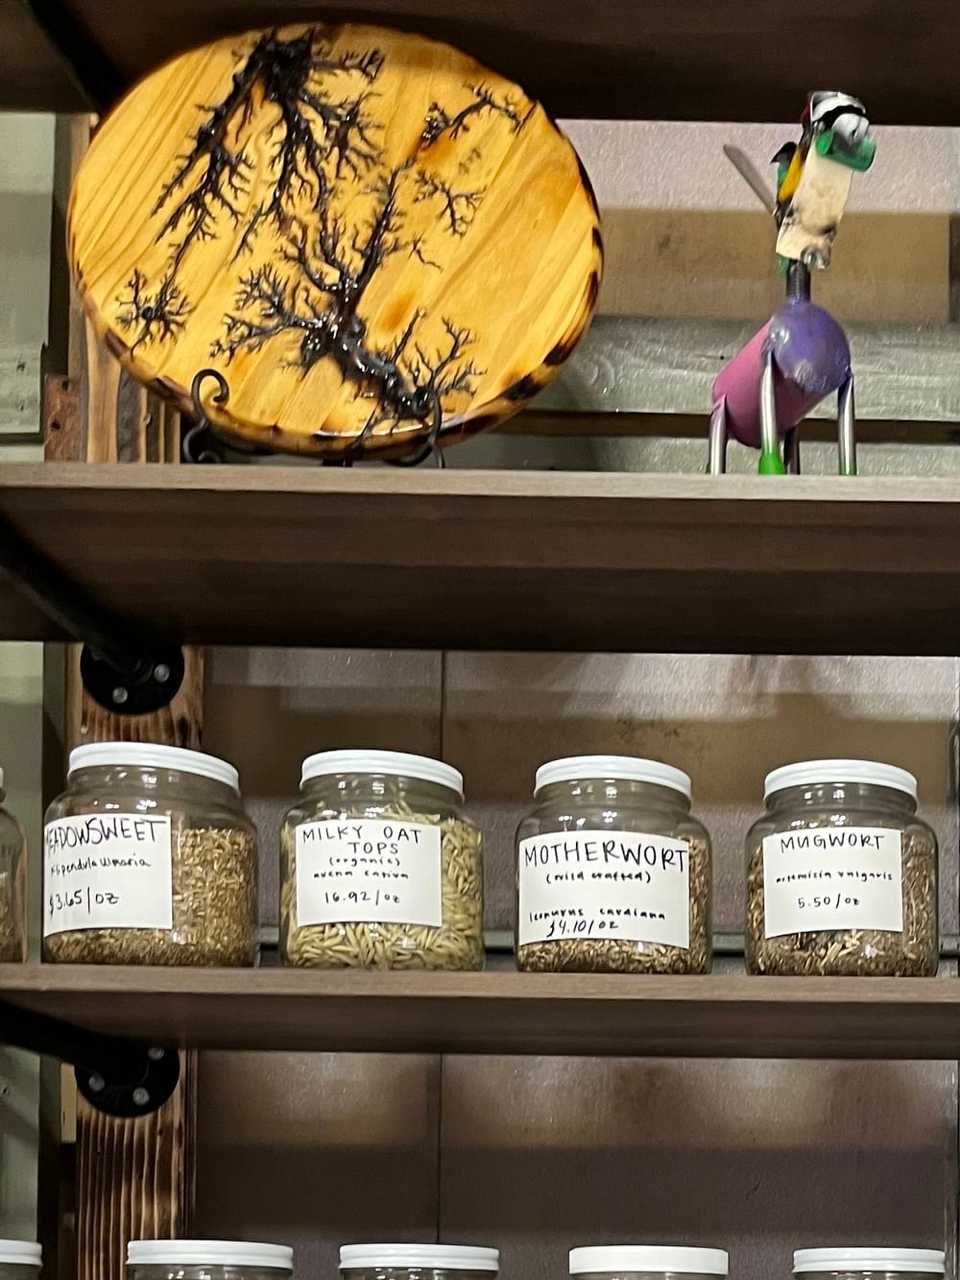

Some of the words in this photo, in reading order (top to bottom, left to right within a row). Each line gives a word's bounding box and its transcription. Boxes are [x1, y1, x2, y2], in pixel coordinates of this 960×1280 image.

[303, 826, 362, 843] MILKY
[383, 826, 422, 844] OAT
[781, 832, 885, 853] MUGWORT
[348, 842, 399, 855] TOPS
[525, 840, 688, 872] MOTHERWORT
